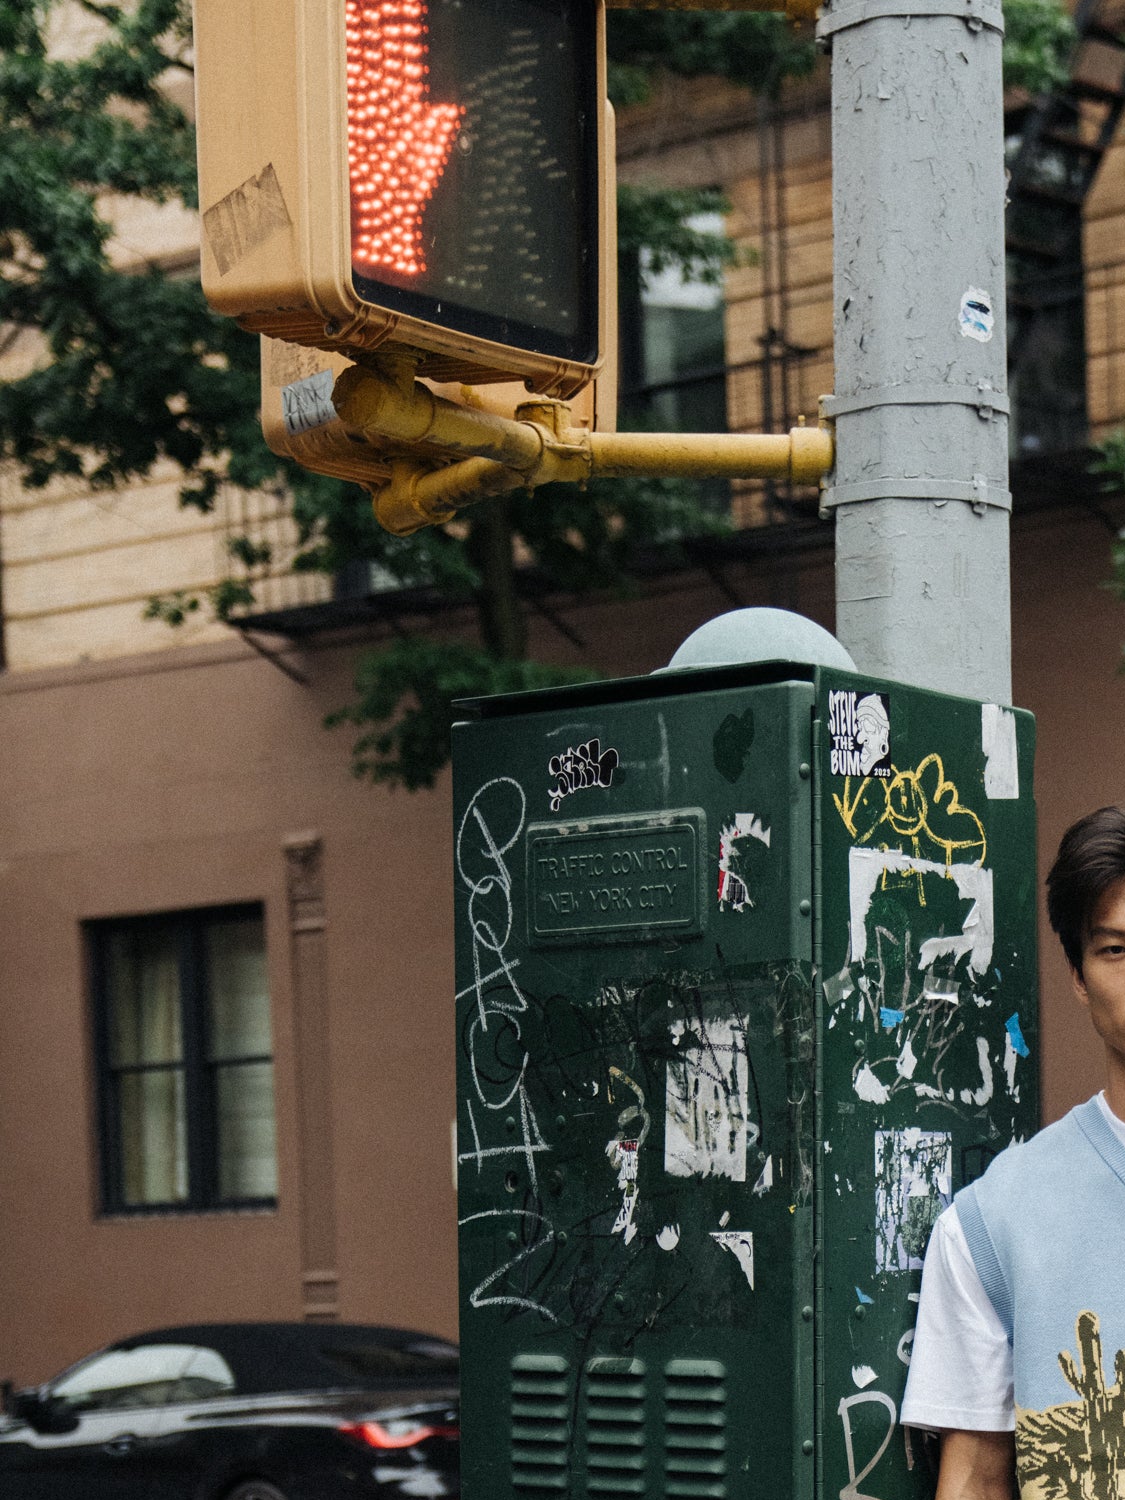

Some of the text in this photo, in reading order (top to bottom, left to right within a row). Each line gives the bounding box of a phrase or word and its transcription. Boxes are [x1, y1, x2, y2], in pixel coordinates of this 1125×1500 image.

[829, 690, 857, 736] STEVE
[833, 736, 854, 750] THE
[831, 750, 860, 776] BUM
[874, 767, 891, 777] 2023
[537, 847, 688, 879] TRAFFIC CONTROL
[547, 883, 677, 913] NEW YORK CITY
